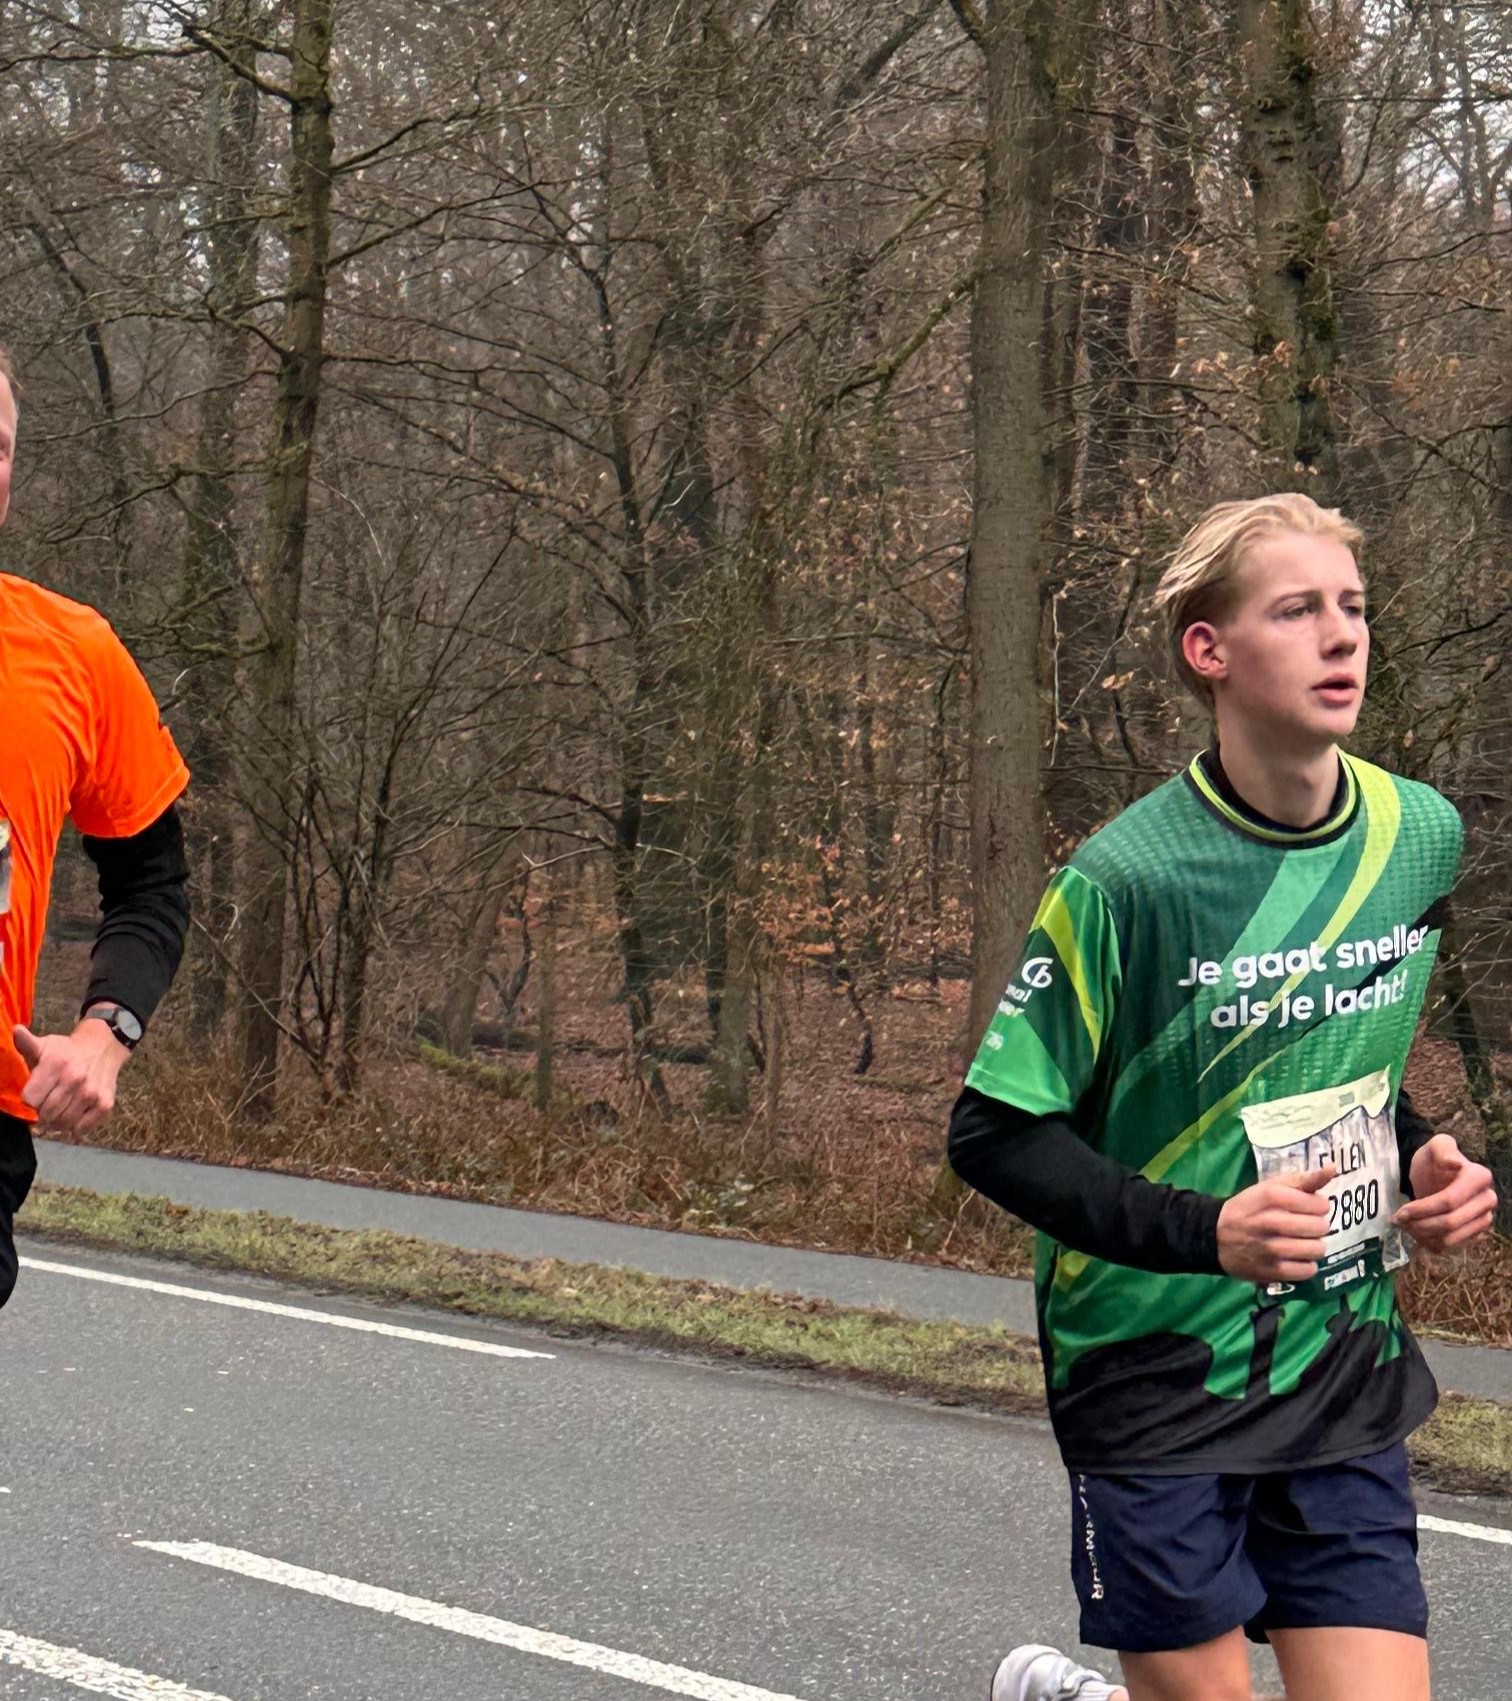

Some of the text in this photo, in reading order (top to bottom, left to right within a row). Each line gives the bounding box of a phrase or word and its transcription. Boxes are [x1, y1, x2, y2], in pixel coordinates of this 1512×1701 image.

[1178, 924, 1429, 989] Je gaat sneller
[1210, 969, 1408, 1028] als je lacht!
